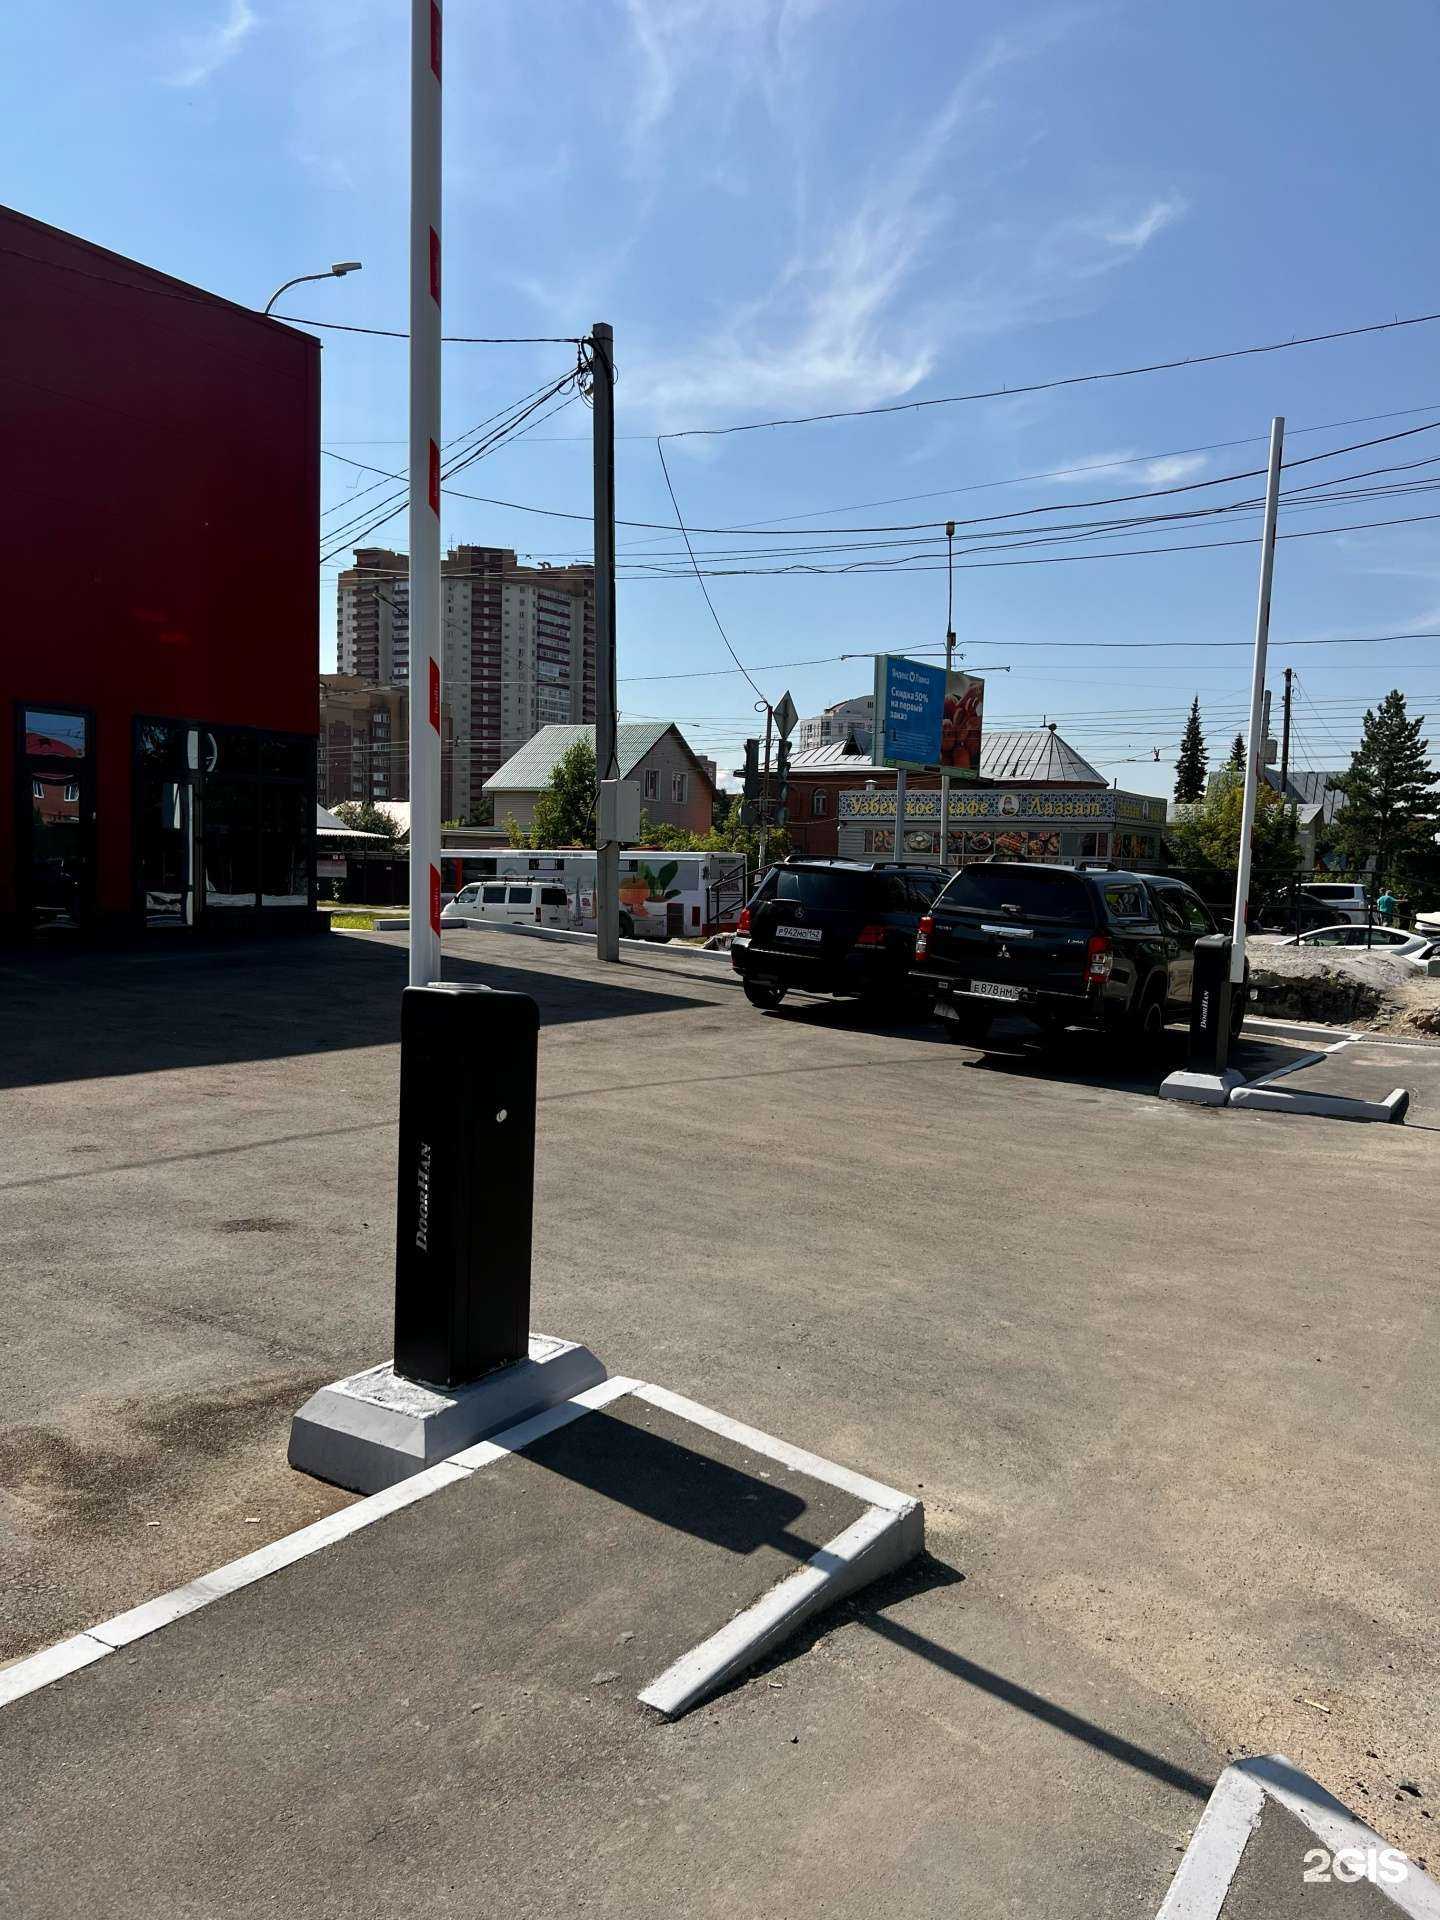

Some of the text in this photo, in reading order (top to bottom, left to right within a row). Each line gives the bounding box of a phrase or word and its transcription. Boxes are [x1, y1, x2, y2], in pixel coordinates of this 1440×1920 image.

[891, 686, 929, 704] Скидка 50%
[890, 700, 923, 713] на первый
